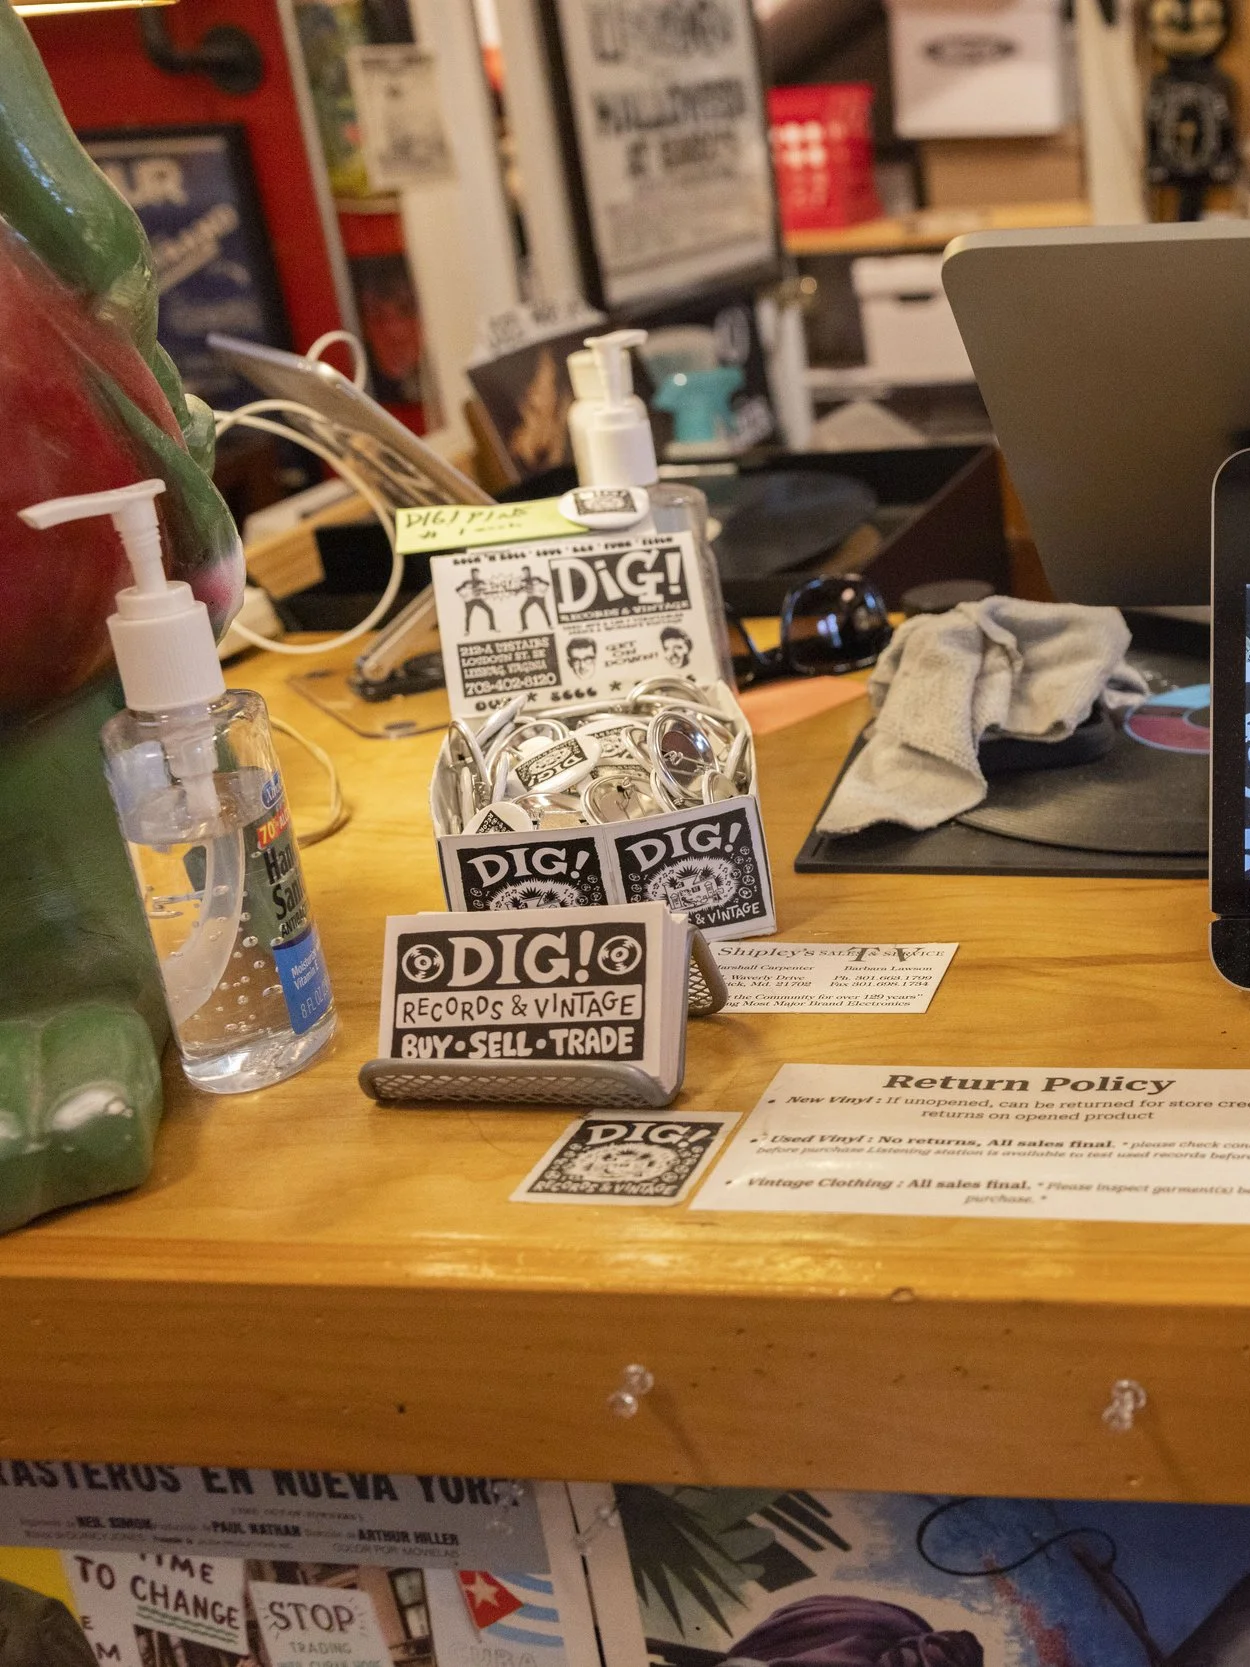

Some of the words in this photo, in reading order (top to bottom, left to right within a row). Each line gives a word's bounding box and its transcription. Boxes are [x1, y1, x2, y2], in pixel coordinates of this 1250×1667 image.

[625, 822, 742, 873] DIG!
[467, 846, 590, 887] DIG!
[707, 902, 760, 923] VINTAGE
[447, 930, 595, 988] DIG!
[718, 947, 815, 958] Shipley's
[402, 994, 504, 1024] RECORDS
[511, 994, 528, 1016] &
[535, 990, 636, 1020] VINTAGE
[401, 1033, 454, 1059] BUY
[468, 1030, 533, 1058] SELL
[549, 1026, 635, 1056] TRADE
[883, 1074, 1029, 1092] Return
[1042, 1076, 1177, 1095] Policy
[786, 1096, 824, 1104] New
[830, 1096, 873, 1106] Vinyl
[886, 1097, 902, 1105] If
[905, 1098, 994, 1109] unopened,
[999, 1101, 1029, 1109] can
[1034, 1100, 1055, 1109] be
[1059, 1100, 1134, 1109] returned
[1139, 1099, 1165, 1108] for
[1169, 1100, 1213, 1108] store
[921, 1109, 984, 1119] returns
[988, 1112, 1011, 1120] on
[1015, 1111, 1080, 1122] opened
[1084, 1111, 1154, 1122] product
[586, 1122, 712, 1148] DIG!
[770, 1135, 816, 1144] Used
[818, 1135, 865, 1145] Vinyl
[878, 1136, 903, 1144] No
[907, 1137, 982, 1147] returns,
[987, 1138, 1013, 1147] All
[1017, 1139, 1065, 1148] sales
[1069, 1139, 1115, 1148] final.
[1131, 1141, 1176, 1150] please
[1179, 1141, 1219, 1150] check
[756, 1146, 800, 1155] before
[801, 1146, 865, 1156] purchase
[866, 1147, 930, 1156] Listening
[933, 1148, 984, 1156] station
[1002, 1149, 1066, 1158] available
[1117, 1151, 1150, 1159] used
[1153, 1151, 1206, 1160] records
[533, 1180, 600, 1194] RECORDS
[613, 1182, 678, 1196] VINTAGE
[747, 1177, 814, 1189] Vintage
[817, 1177, 894, 1190] Clothing
[907, 1179, 933, 1188] All
[935, 1180, 982, 1189] sales
[985, 1180, 1031, 1190] final.
[1047, 1181, 1094, 1191] Please
[200, 1466, 254, 1495] EN
[270, 1470, 398, 1502] NUEVA
[74, 1555, 116, 1590] TO
[130, 1575, 240, 1630] CHANGE
[269, 1600, 354, 1632] STOP
